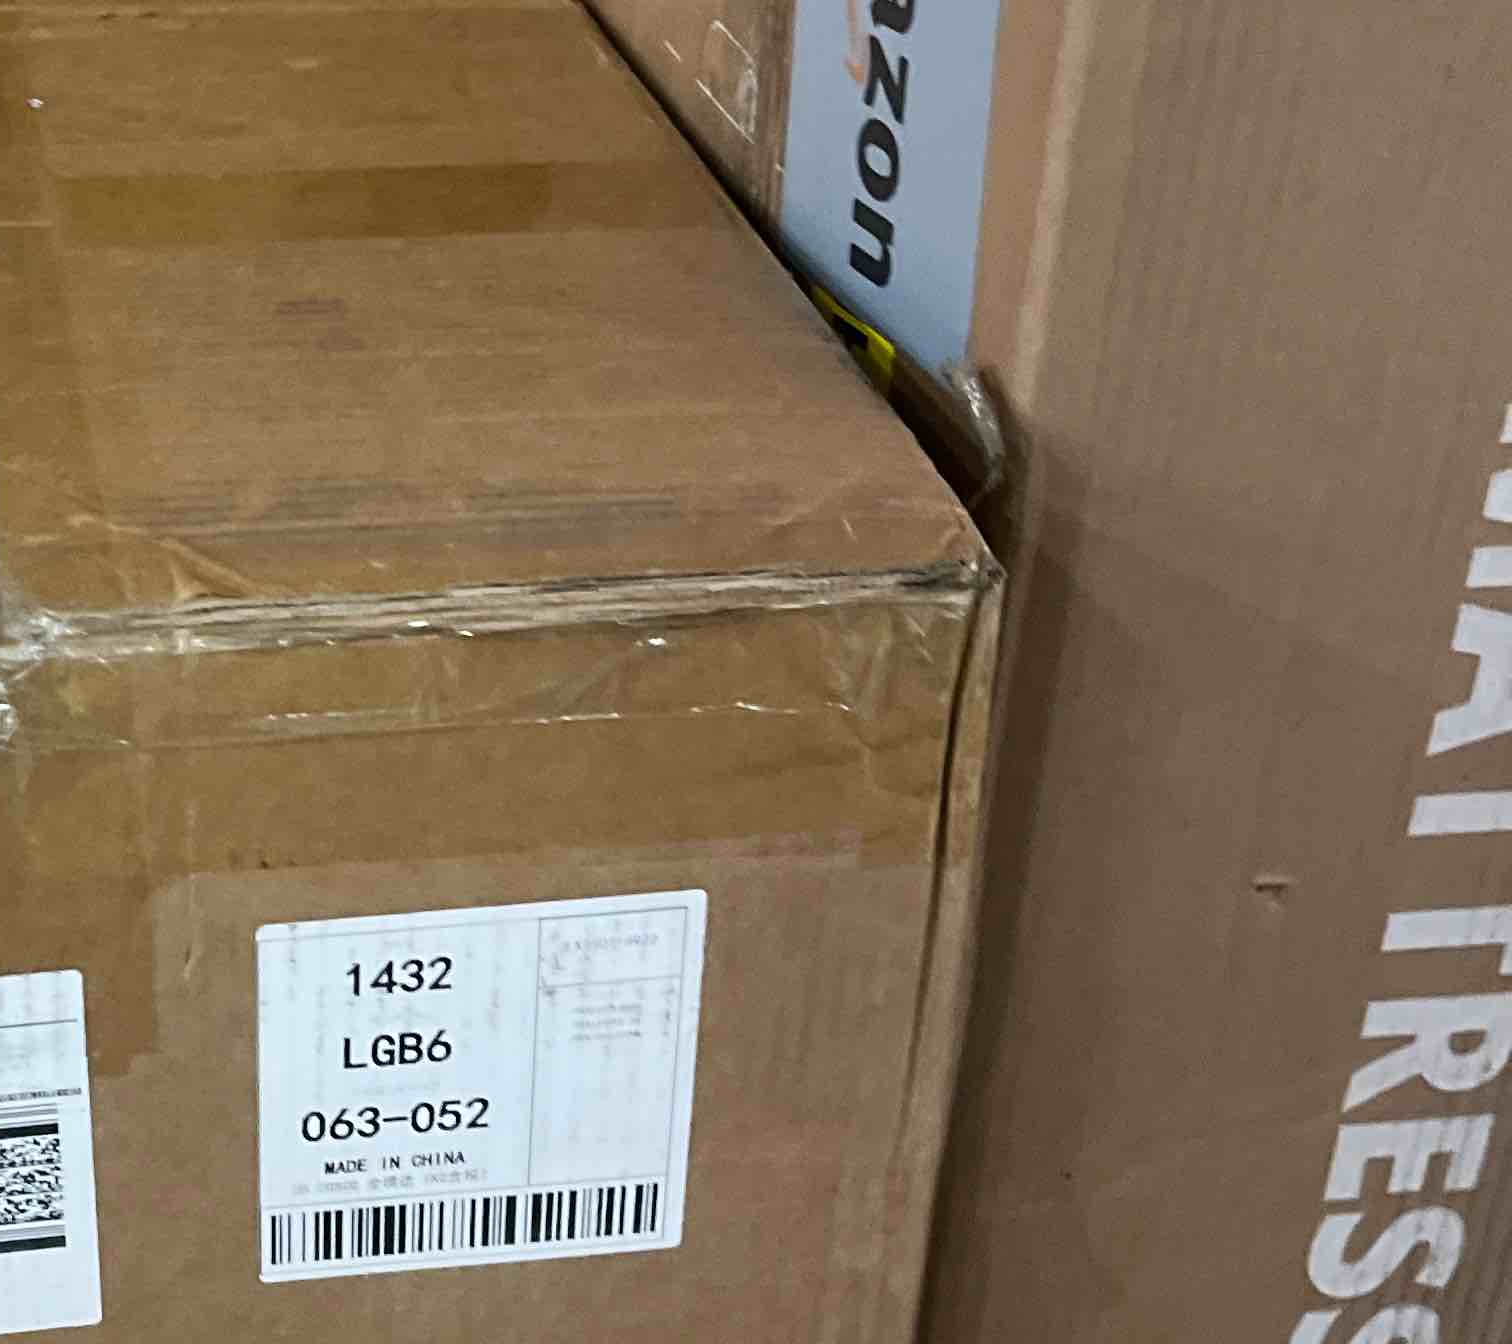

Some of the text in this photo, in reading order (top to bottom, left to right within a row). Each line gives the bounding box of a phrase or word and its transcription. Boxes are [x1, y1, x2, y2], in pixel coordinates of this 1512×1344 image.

[345, 956, 454, 997] 1432
[343, 1030, 453, 1070] LGB6
[301, 1097, 490, 1142] 063-052
[324, 1151, 465, 1174] MADE IN CHINA
